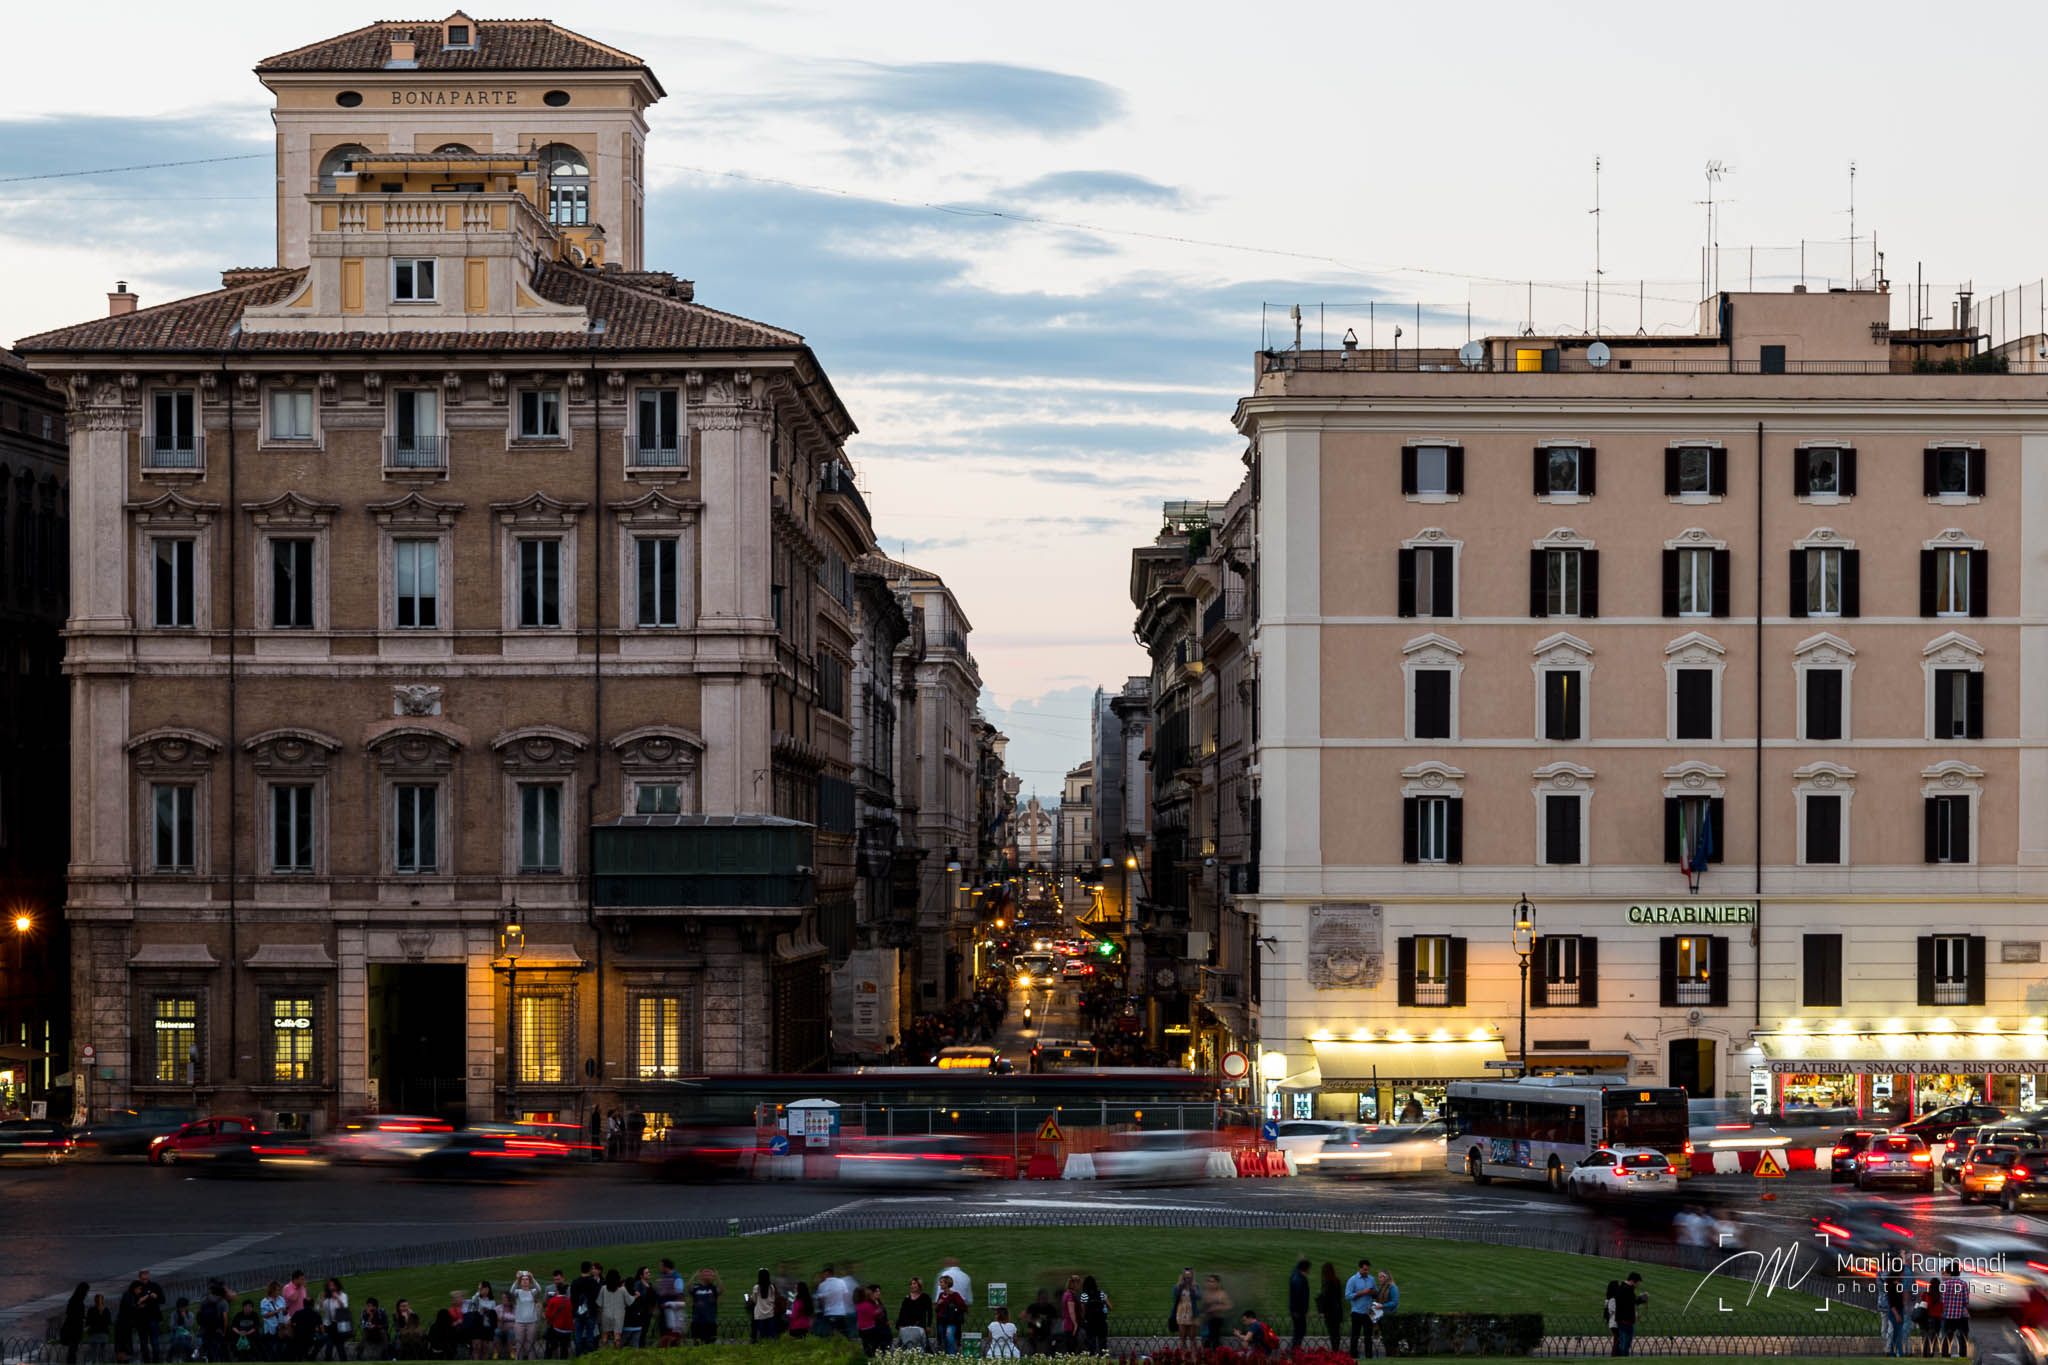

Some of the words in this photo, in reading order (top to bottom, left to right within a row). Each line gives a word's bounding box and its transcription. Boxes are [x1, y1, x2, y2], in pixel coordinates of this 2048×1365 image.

[391, 91, 518, 105] BONAPARTE
[1628, 906, 1756, 924] CARABINIERI
[1771, 1062, 1853, 1074] GELATERIA
[1865, 1062, 1916, 1074] SNACK
[1919, 1062, 1950, 1074] BAR
